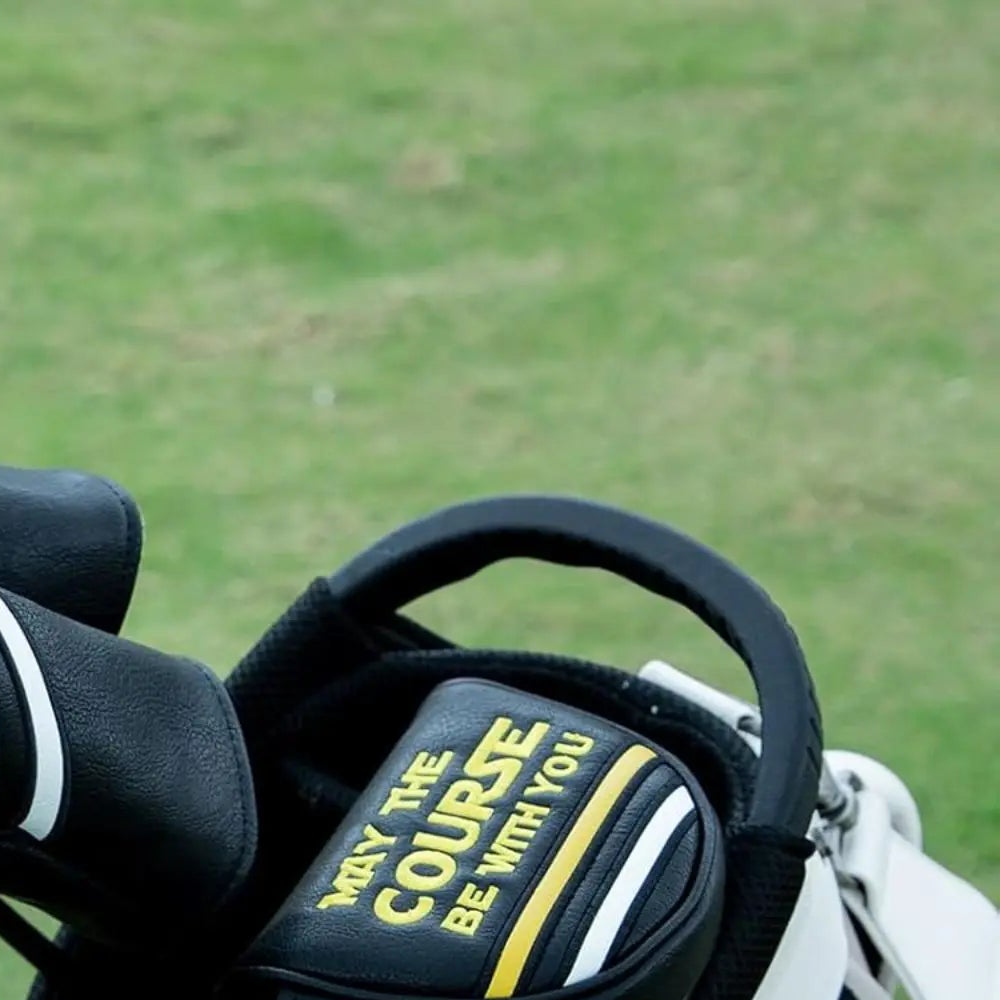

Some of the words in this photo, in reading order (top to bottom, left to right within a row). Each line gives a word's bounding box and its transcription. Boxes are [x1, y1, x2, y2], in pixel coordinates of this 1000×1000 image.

[315, 824, 397, 909] MAY
[379, 750, 454, 815] THE
[373, 716, 550, 925] COURSE
[440, 882, 500, 936] BE
[474, 801, 550, 876] WITH
[524, 731, 595, 797] YOU
